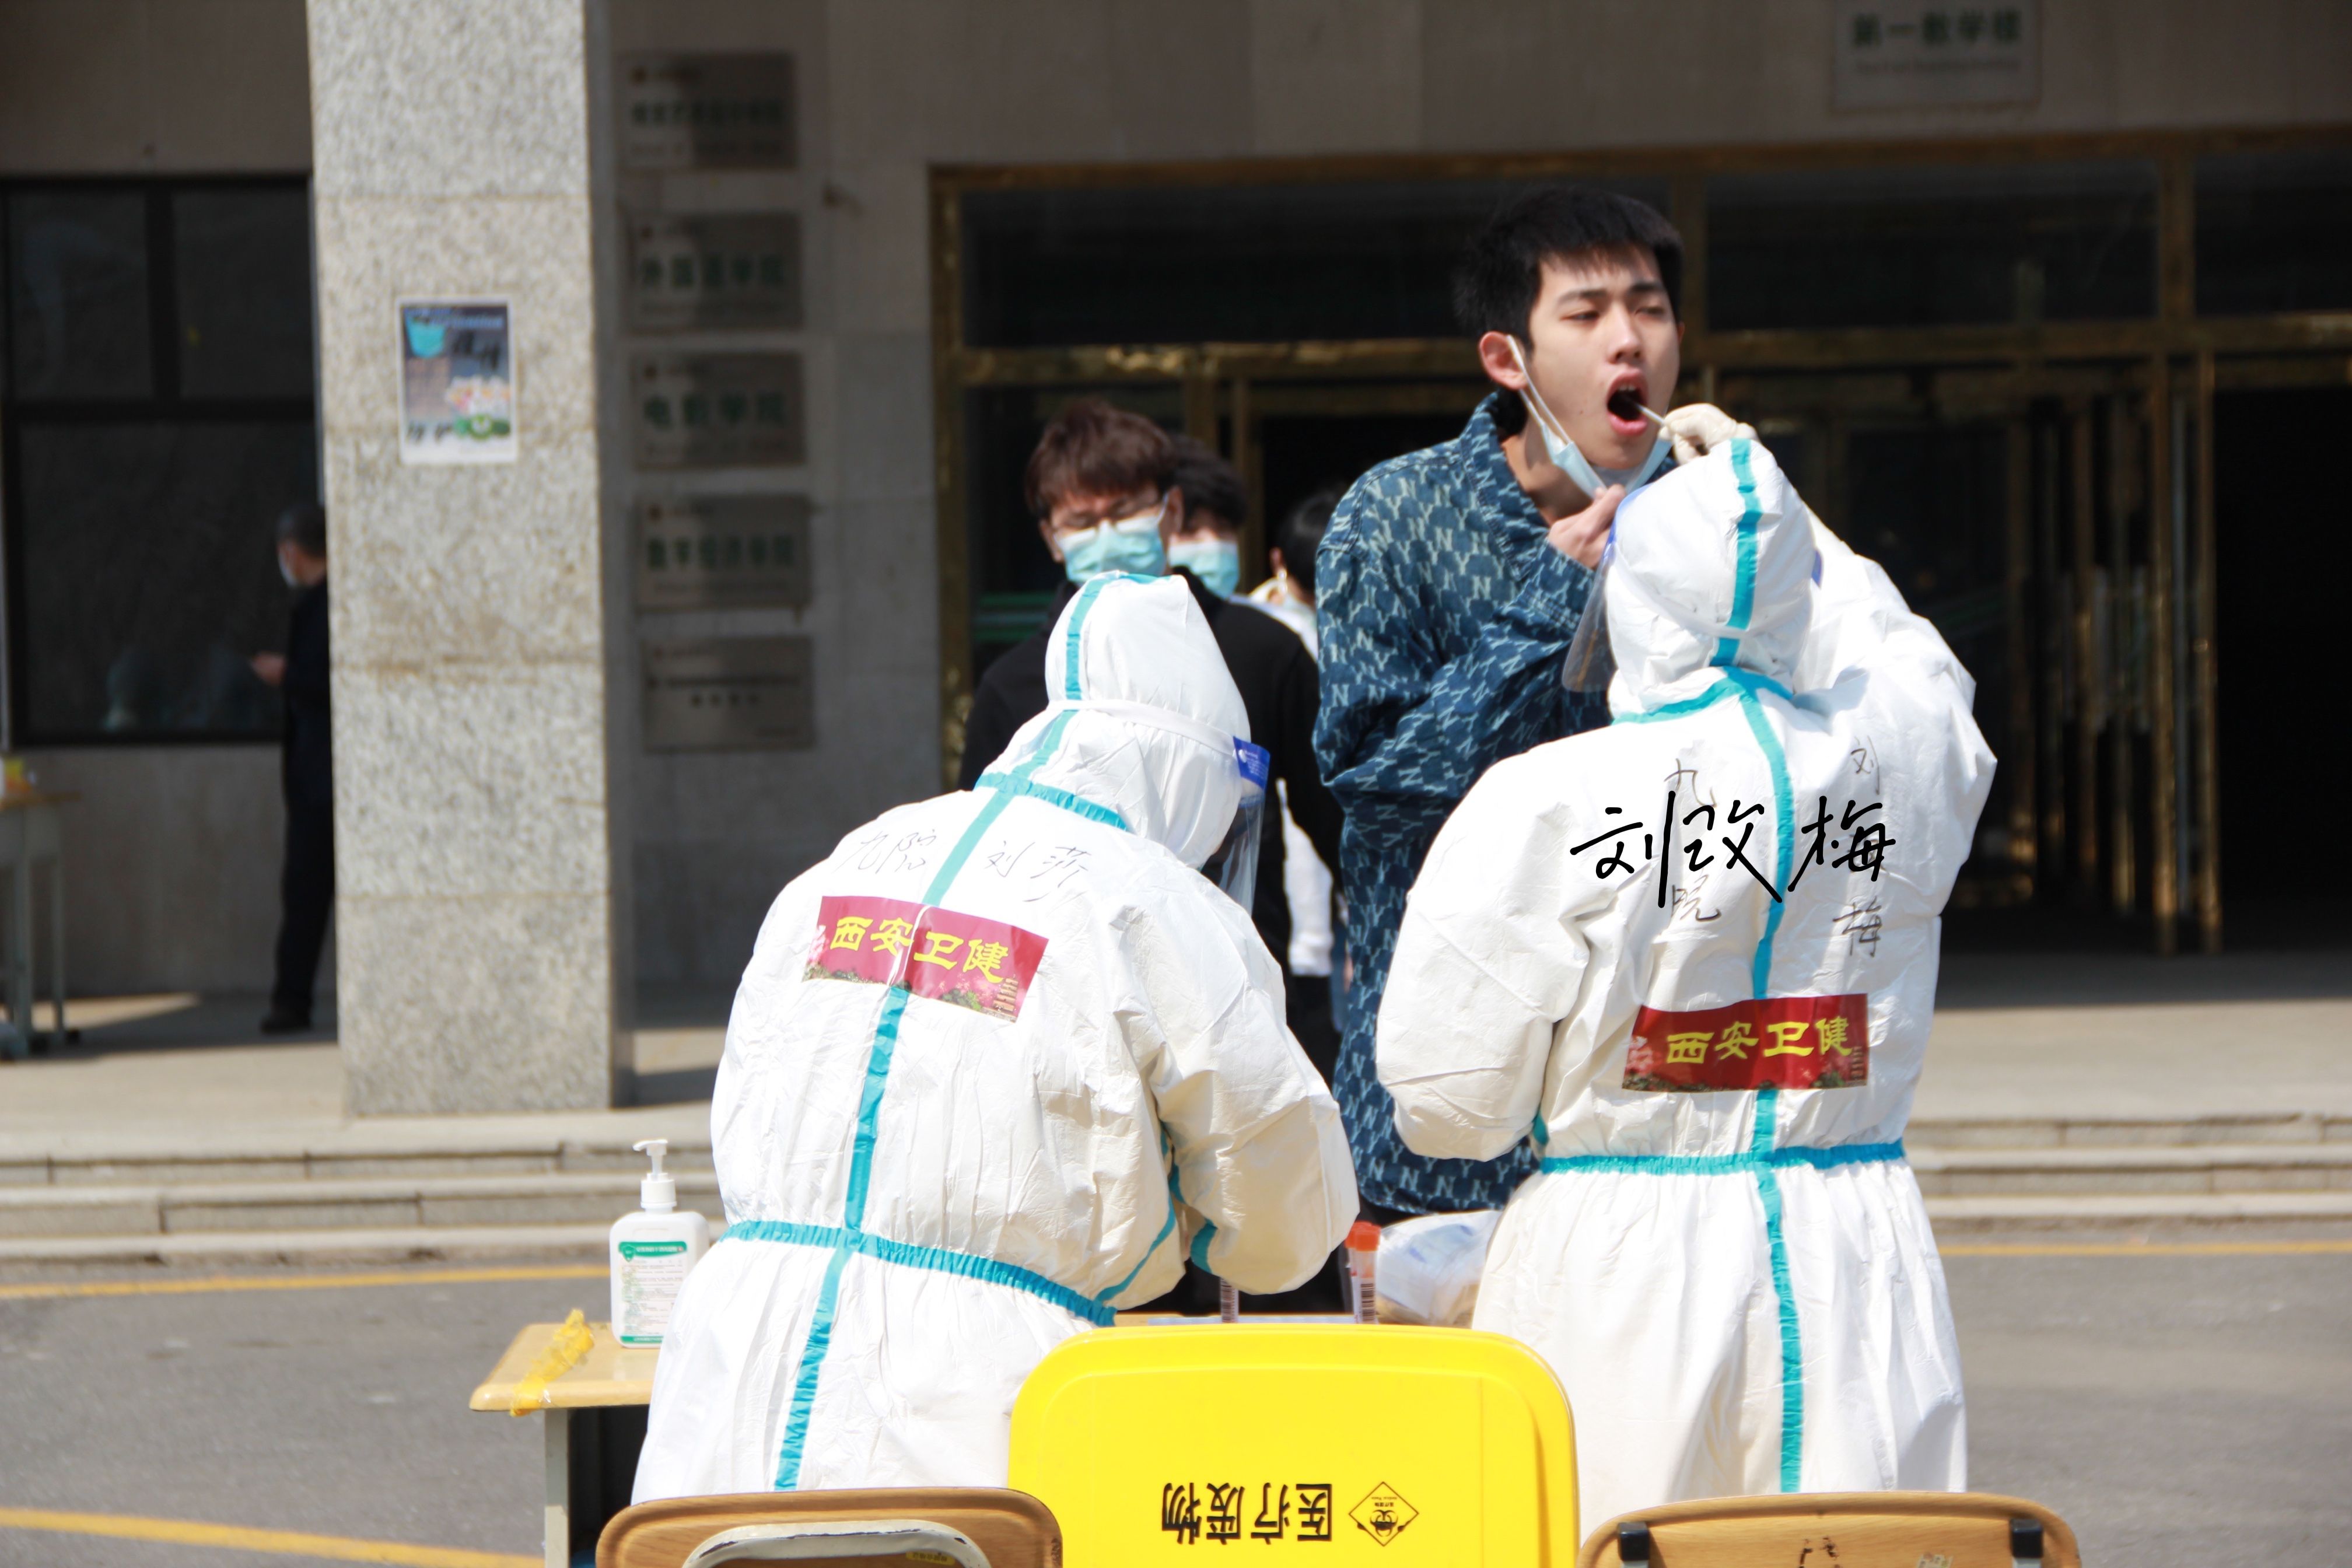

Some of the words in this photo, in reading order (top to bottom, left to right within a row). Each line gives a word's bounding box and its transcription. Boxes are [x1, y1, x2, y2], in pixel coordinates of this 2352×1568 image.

[830, 916, 1010, 984] 西安卫健
[1665, 1015, 1853, 1065] 西安卫健
[1161, 1482, 1332, 1545] 医疗废物
